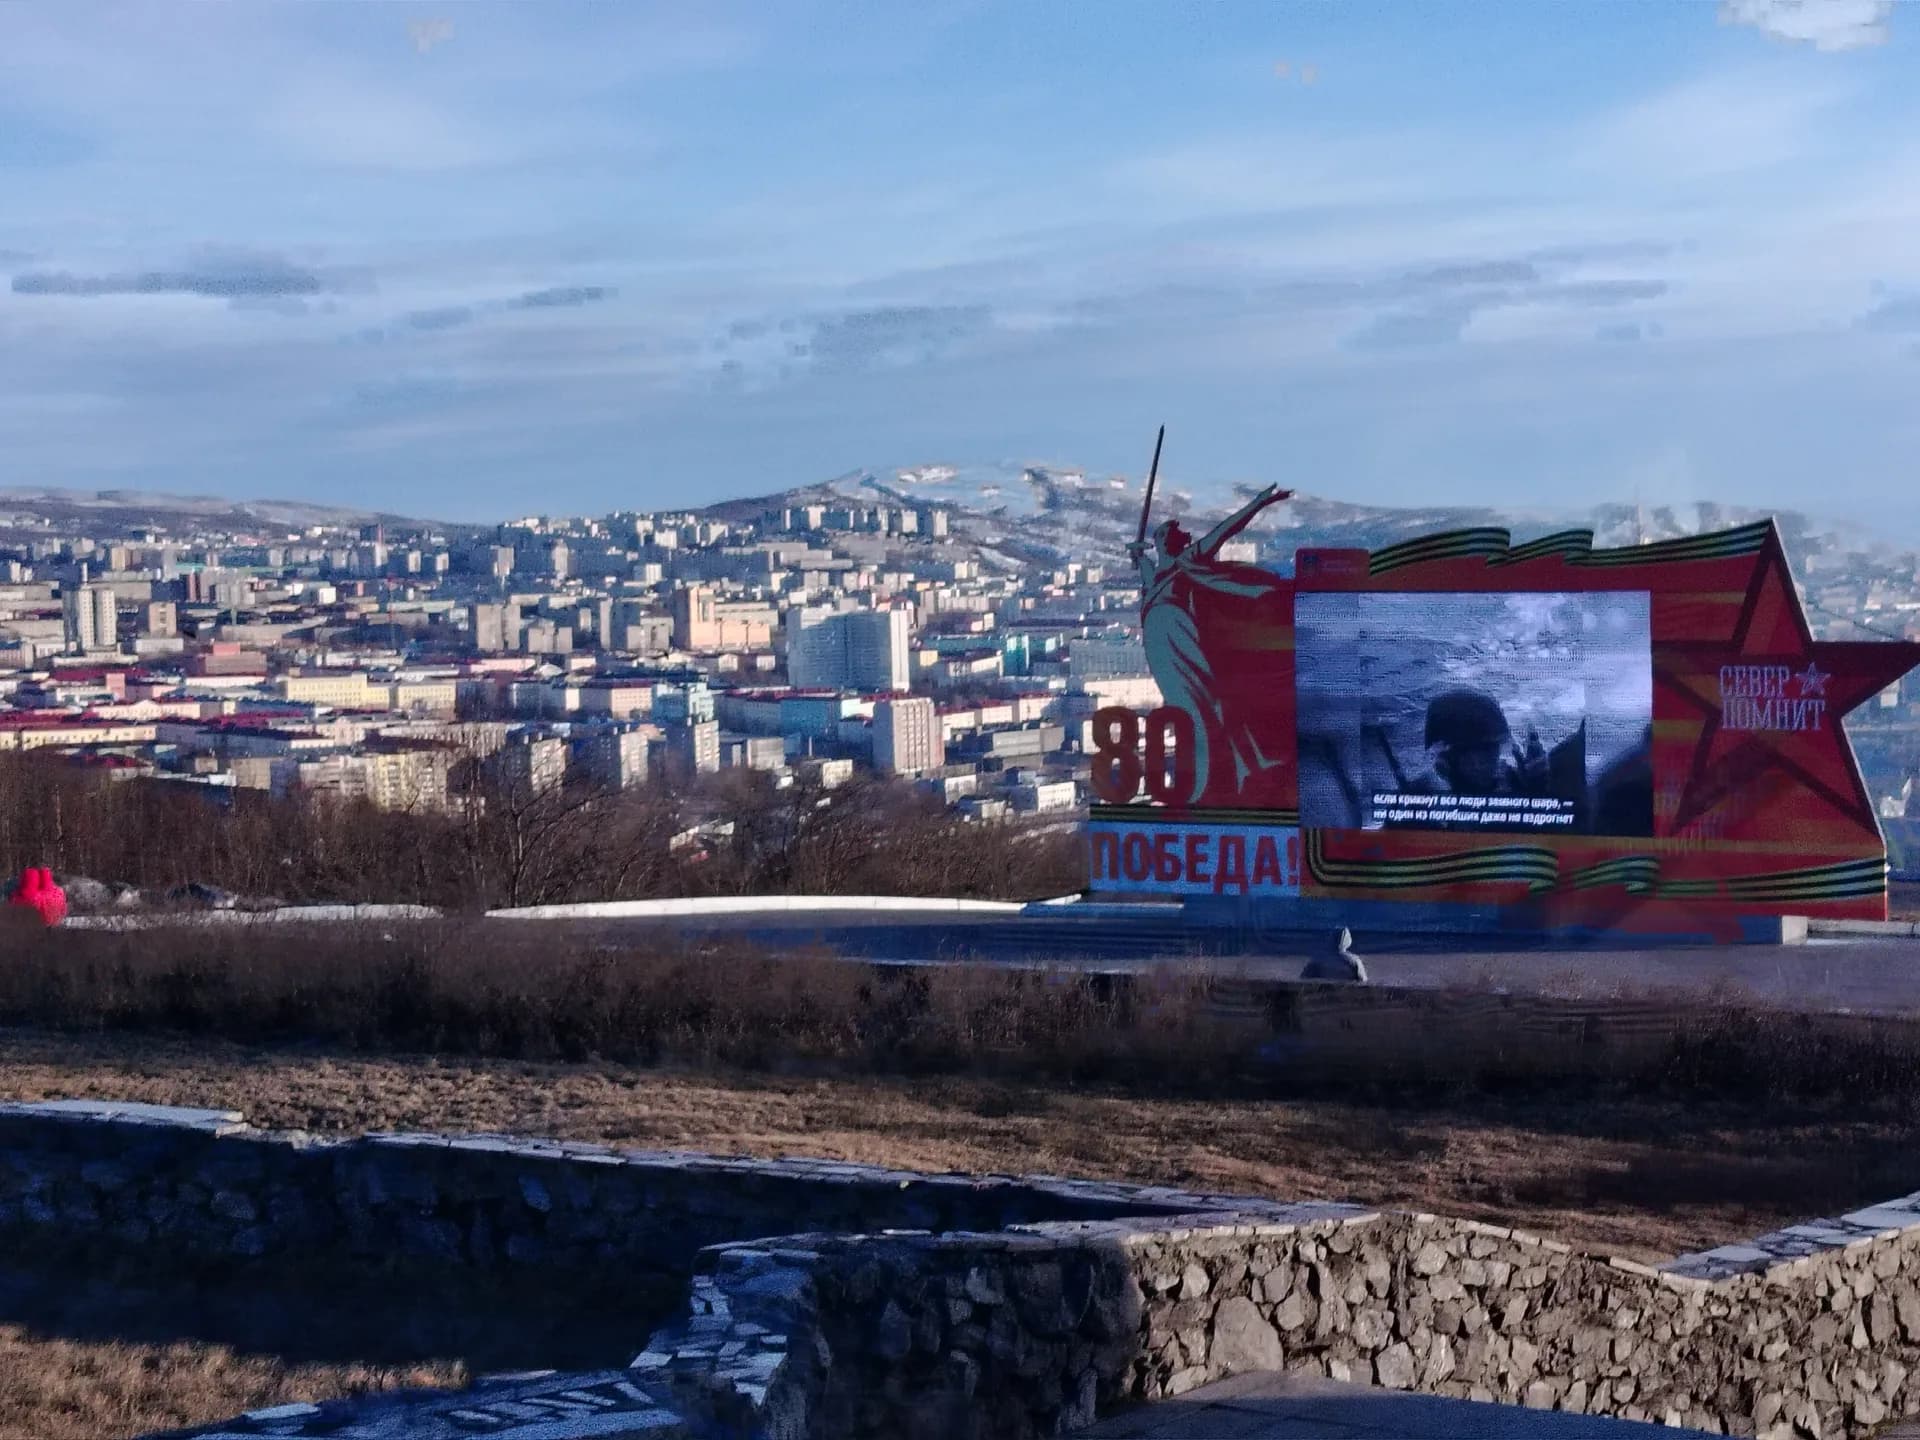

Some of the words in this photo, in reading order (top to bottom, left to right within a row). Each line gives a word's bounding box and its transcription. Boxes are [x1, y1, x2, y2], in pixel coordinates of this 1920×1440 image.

[1720, 665, 1790, 697] СЕВЕР
[1721, 698, 1826, 731] ПОМНИТ
[1090, 705, 1196, 804] 80
[1373, 809, 1387, 819] ни
[1388, 809, 1414, 822] один
[1415, 810, 1428, 820] из
[1429, 809, 1479, 821] погибших
[1480, 812, 1507, 824] даже
[1508, 812, 1521, 822] не
[1522, 813, 1574, 825] вздрогнет
[1459, 797, 1486, 808] люди
[1091, 832, 1298, 895] ПОБЕДА!
